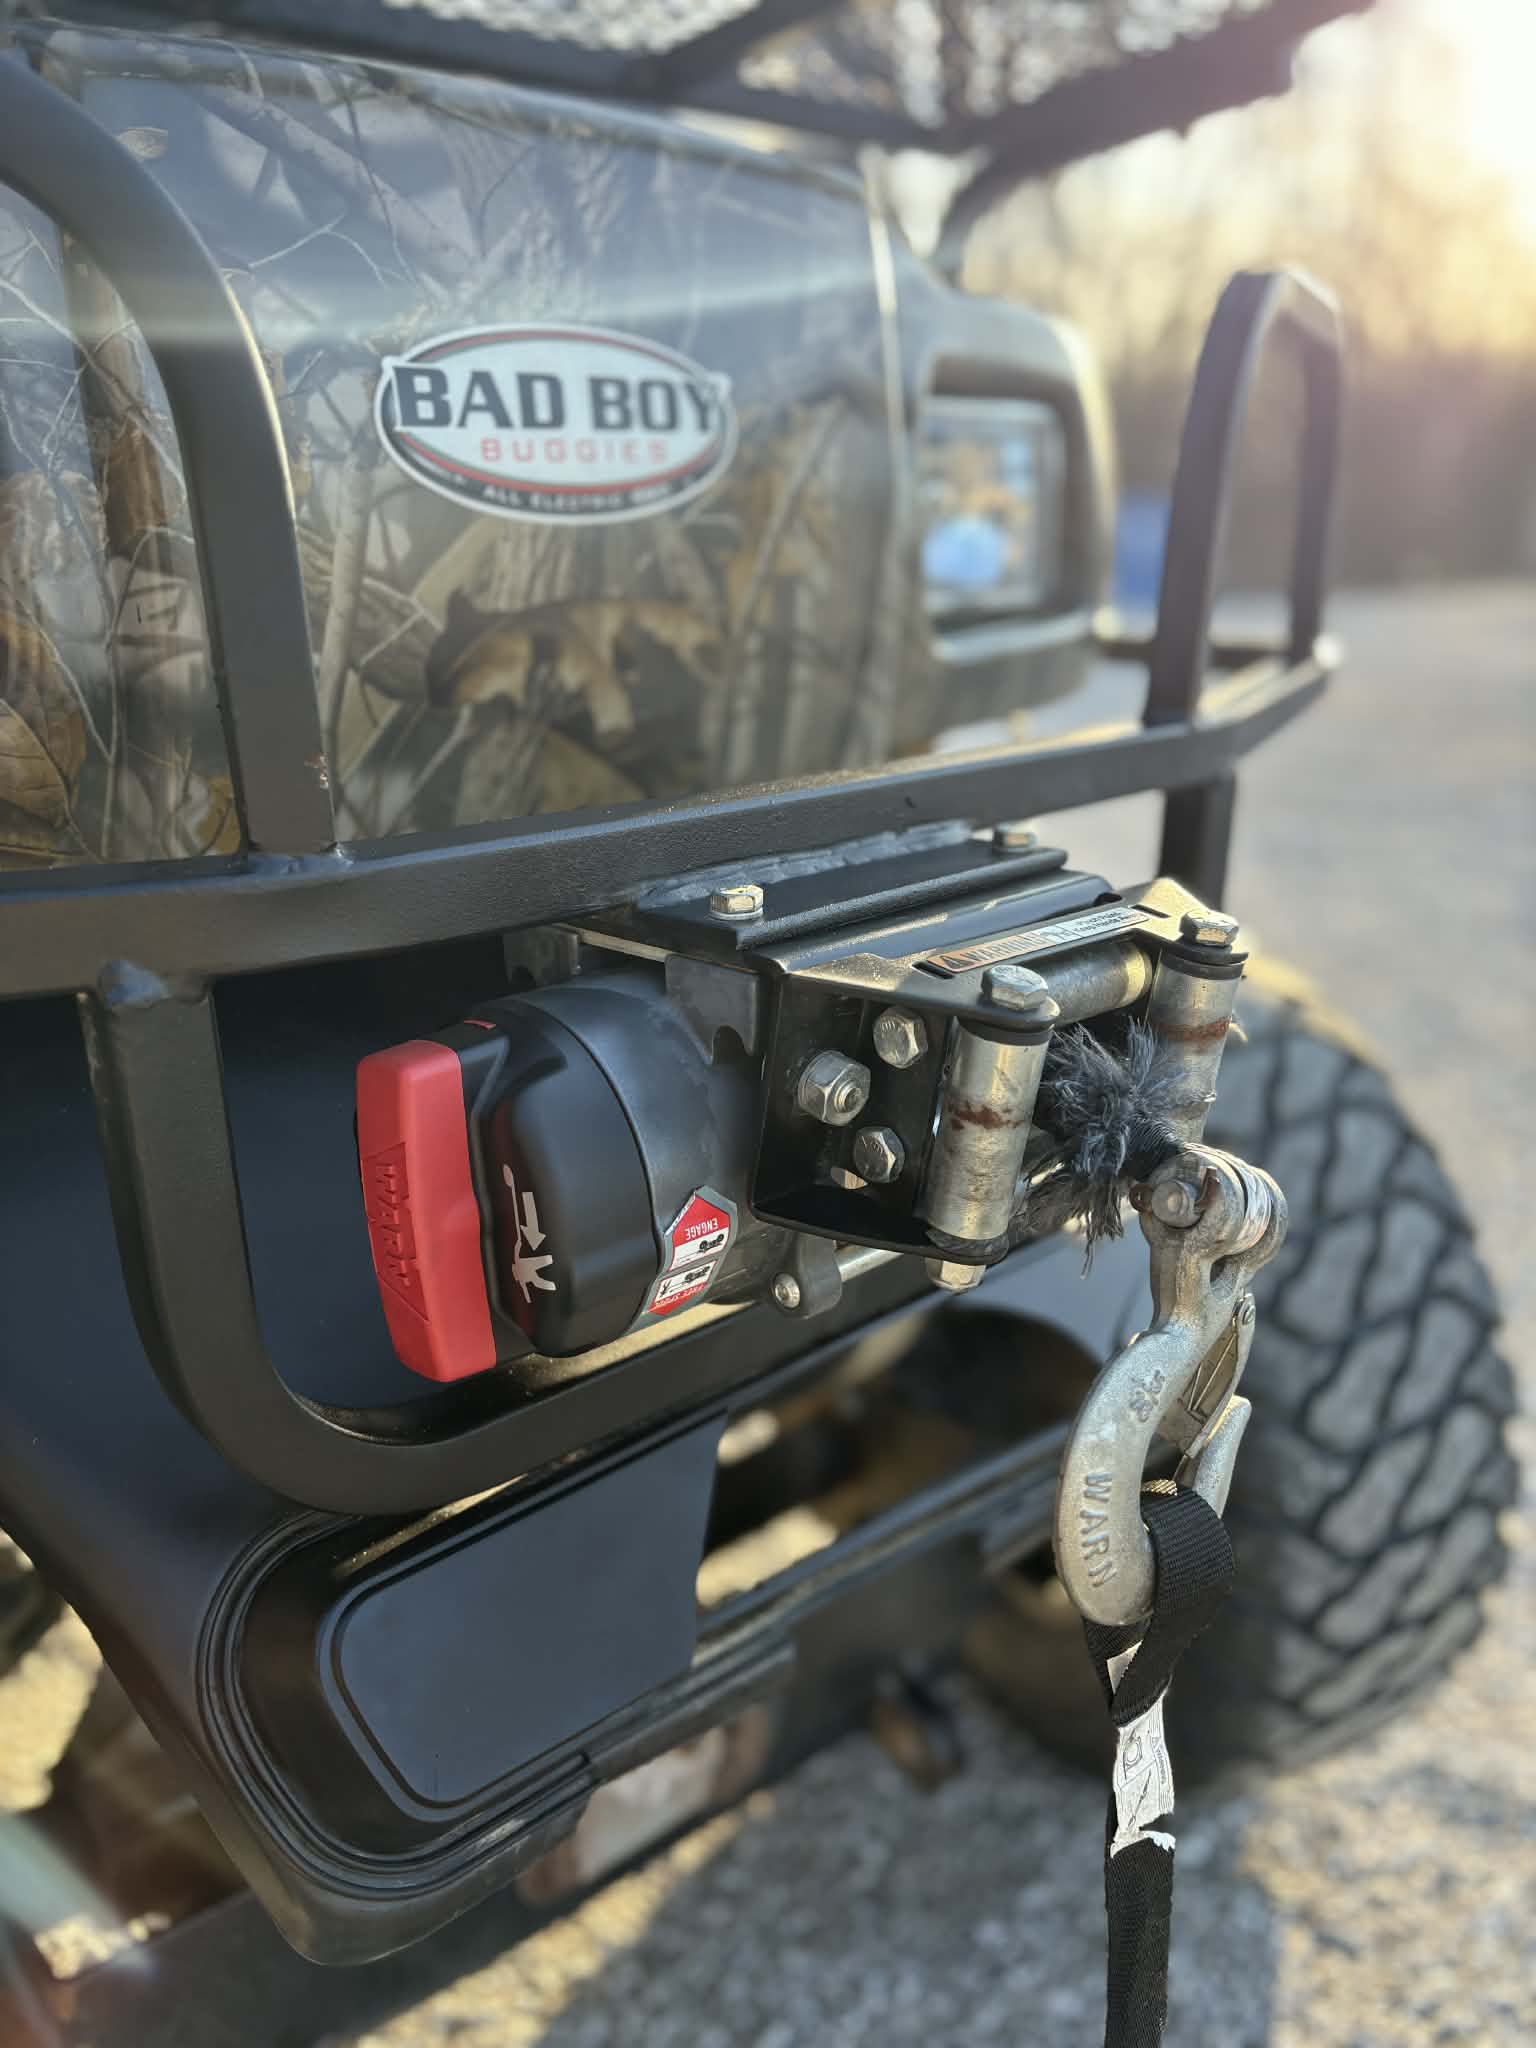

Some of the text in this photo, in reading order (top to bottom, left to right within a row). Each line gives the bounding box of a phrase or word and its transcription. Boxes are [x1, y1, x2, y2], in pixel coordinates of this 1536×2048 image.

[392, 365, 718, 433] BAD BOY
[480, 437, 668, 464] BUGGIES
[964, 930, 1050, 964] WARNING
[374, 1162, 411, 1288] WARN
[685, 1217, 718, 1241] ENGAGE
[1079, 1471, 1118, 1588] WARN
